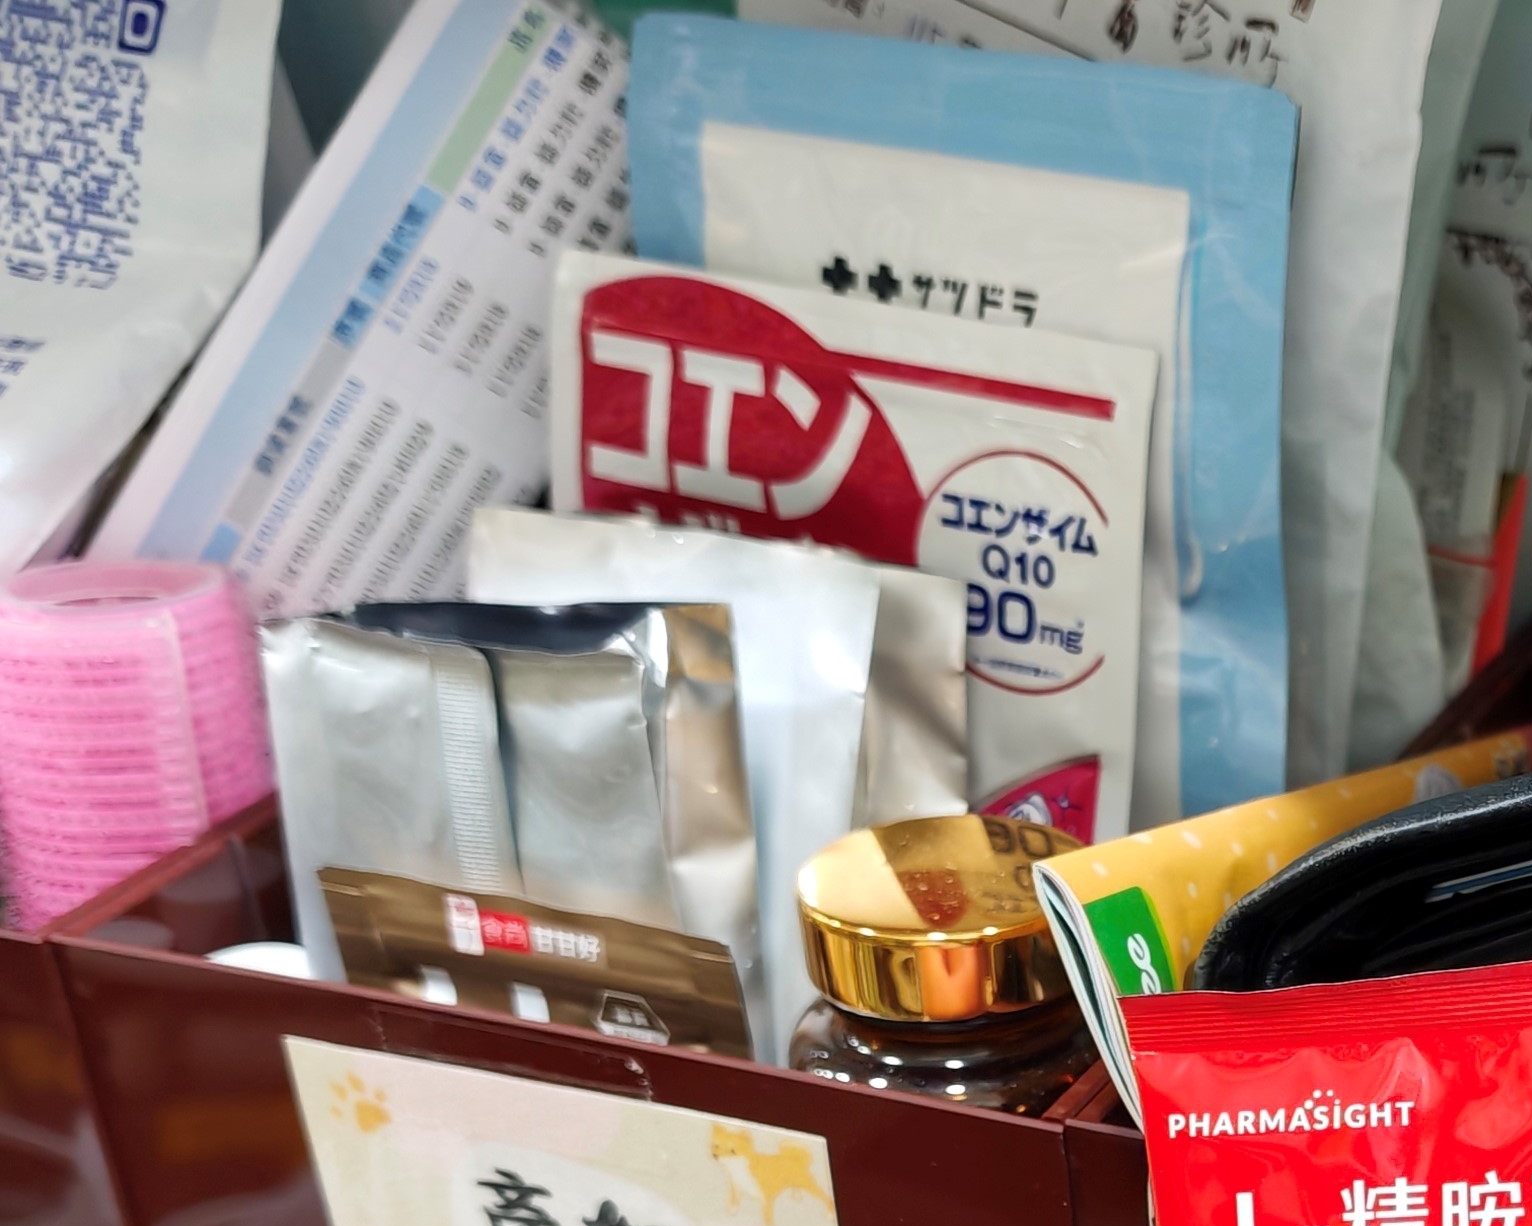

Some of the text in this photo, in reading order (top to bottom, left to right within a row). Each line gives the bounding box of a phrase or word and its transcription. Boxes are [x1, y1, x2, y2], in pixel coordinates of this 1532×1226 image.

[912, 271, 1040, 328] サツドラ
[589, 330, 873, 522] コエン
[938, 492, 1099, 557] コエンザイム
[981, 545, 1056, 590] Q10
